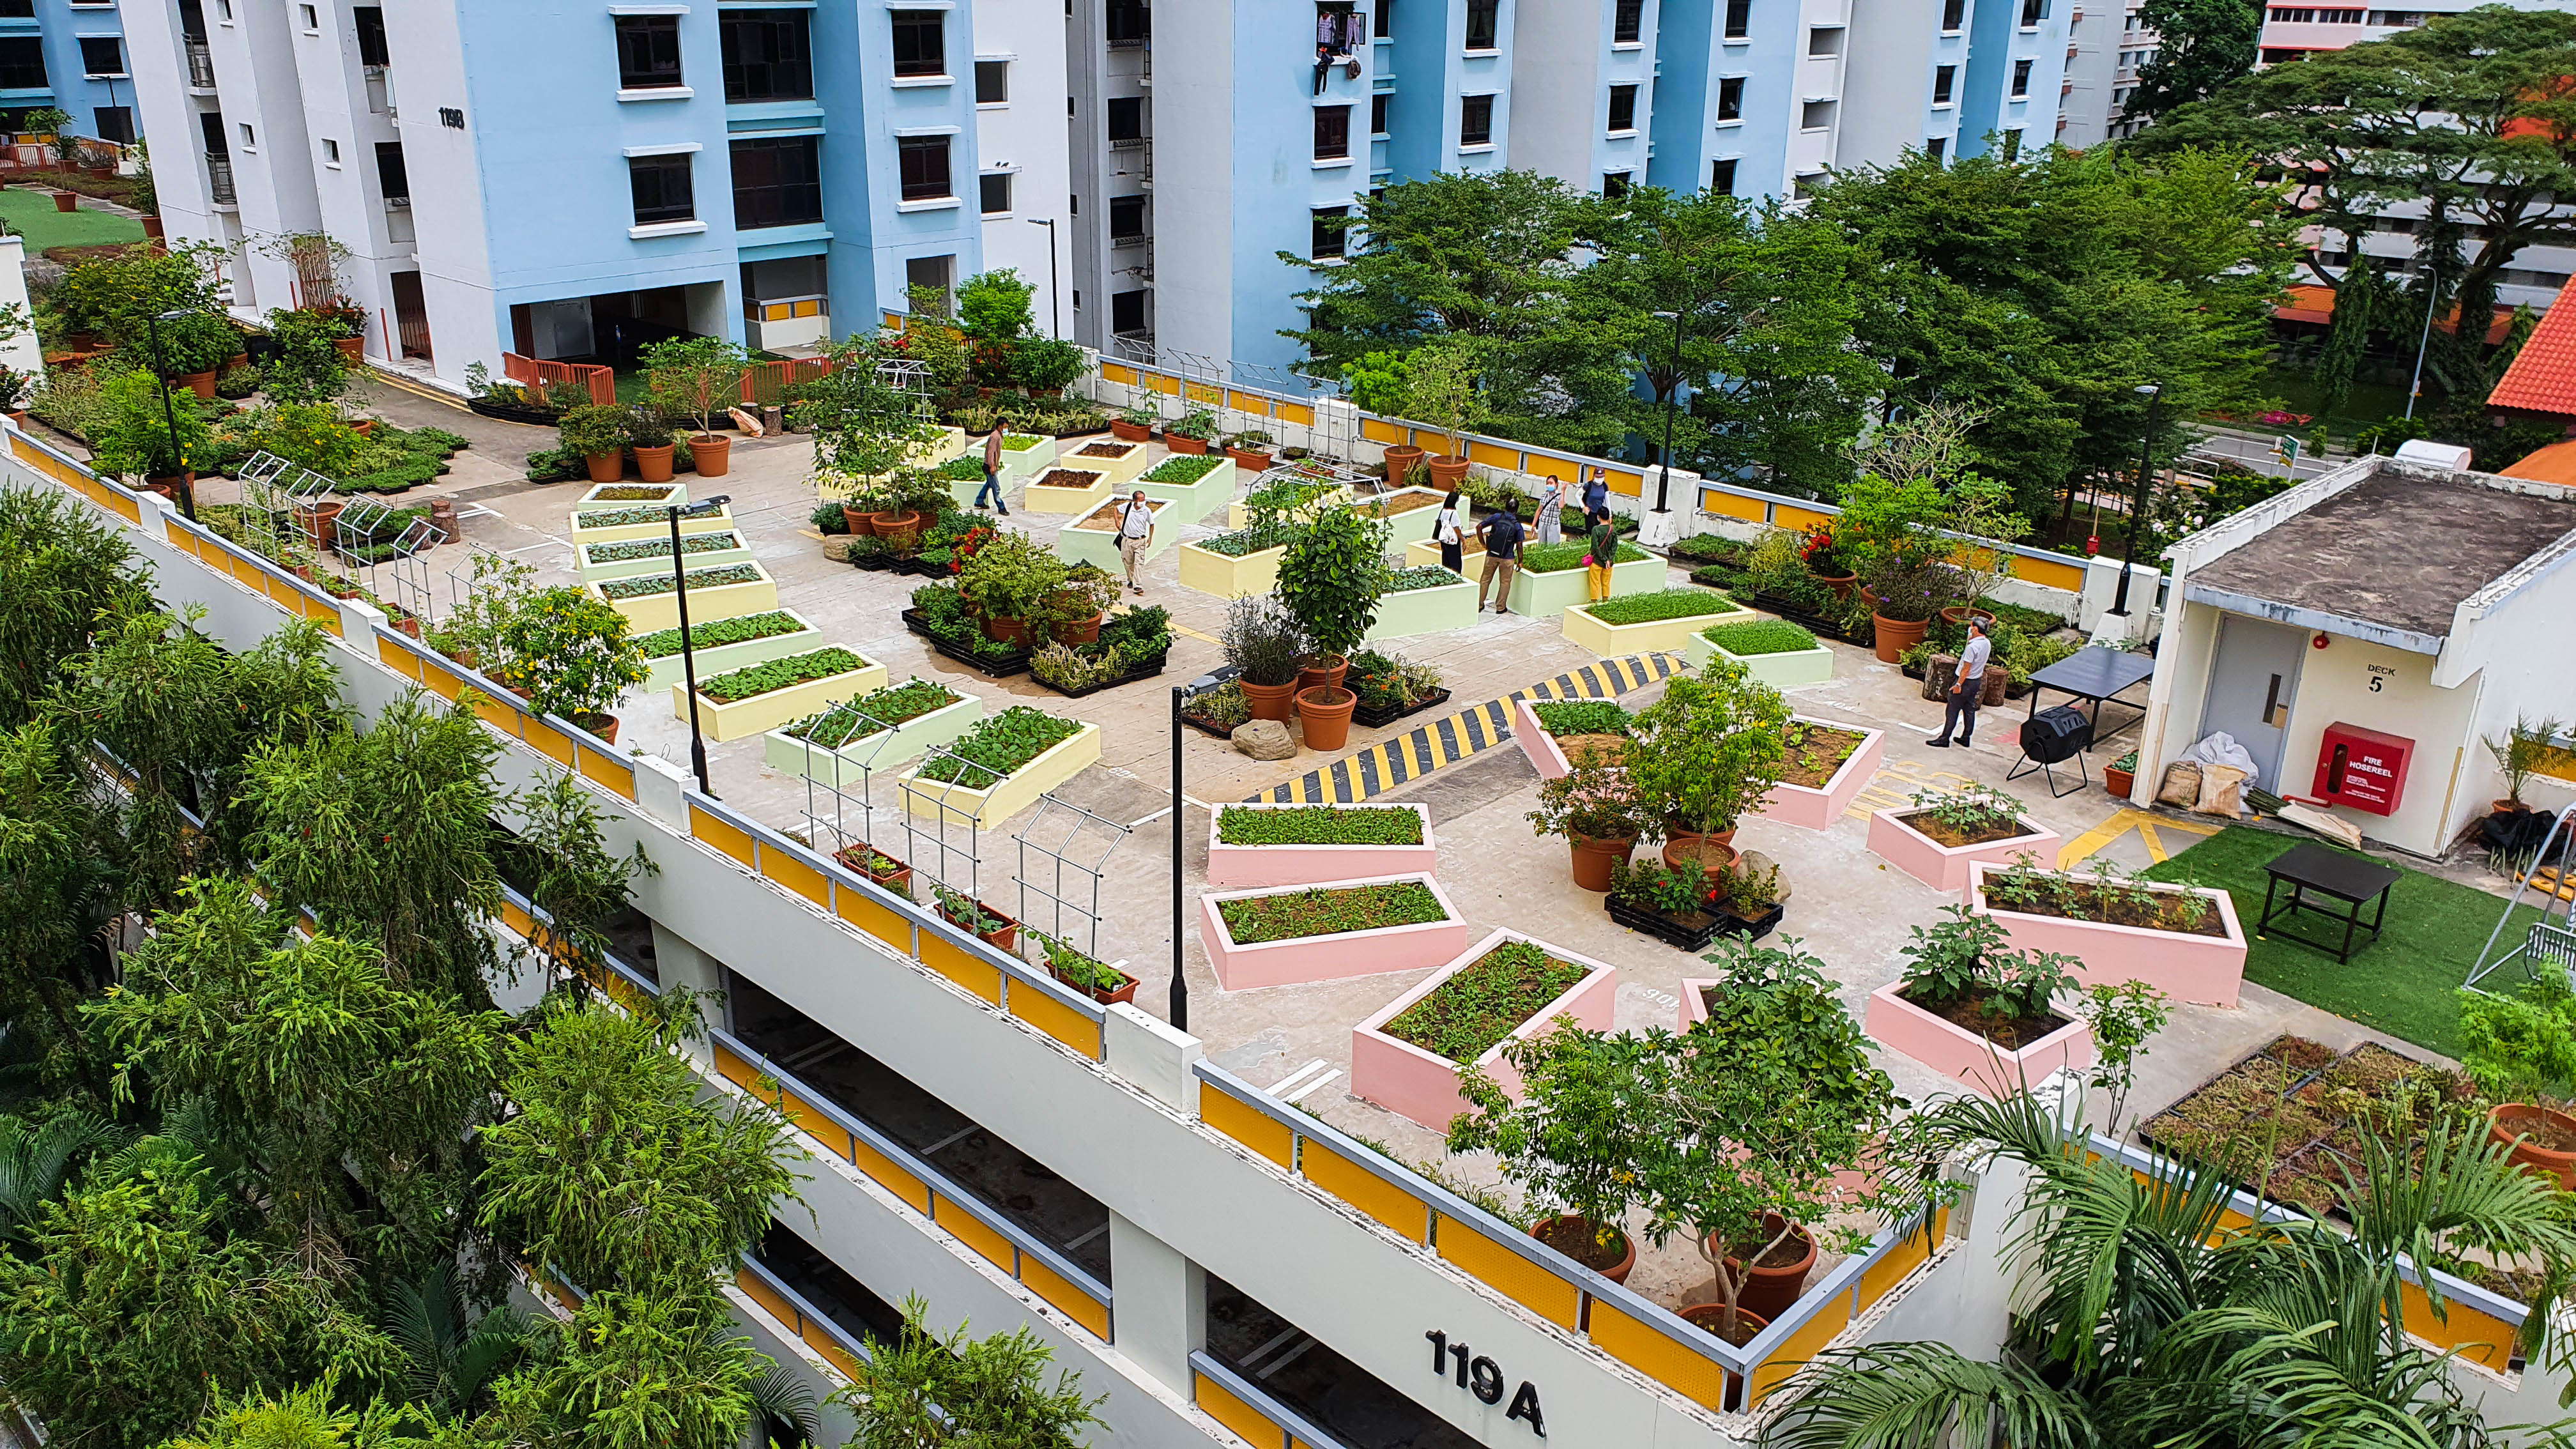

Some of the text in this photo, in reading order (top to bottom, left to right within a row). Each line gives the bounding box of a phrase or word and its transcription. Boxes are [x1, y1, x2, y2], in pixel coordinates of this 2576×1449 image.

[438, 107, 465, 130] 119B
[2367, 664, 2396, 677] DECK
[2368, 676, 2383, 693] 5
[2349, 761, 2393, 778] HOSEREEL
[2363, 756, 2382, 766] FIRE
